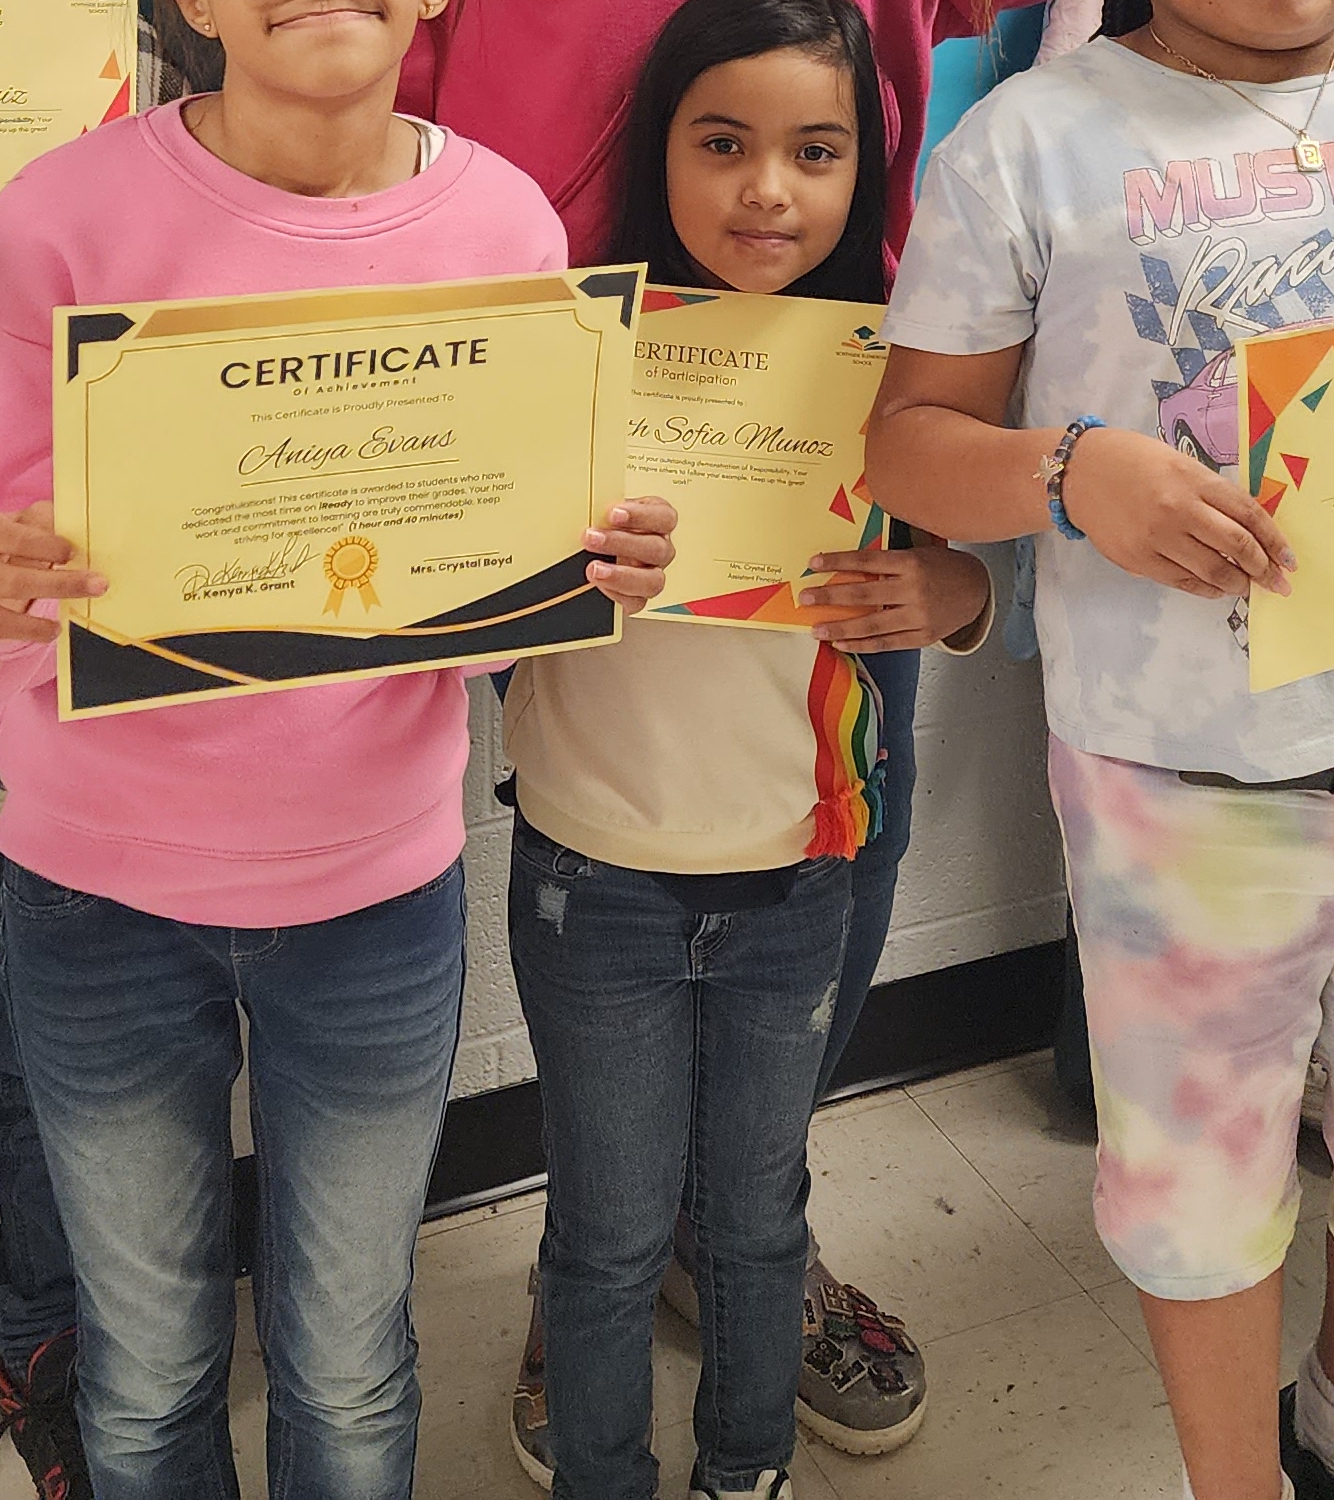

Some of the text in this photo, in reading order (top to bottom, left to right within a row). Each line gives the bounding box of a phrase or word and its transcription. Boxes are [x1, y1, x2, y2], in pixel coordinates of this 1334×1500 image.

[221, 338, 489, 389] CERTIFICATE
[634, 341, 769, 370] ERTIFICATE
[293, 377, 417, 396] Of Achievement
[645, 366, 737, 387] of Participation
[251, 393, 454, 422] This Certificate is Proudly Presented To
[238, 426, 457, 476] Aniya Evans
[654, 416, 729, 451] Sofia
[734, 422, 834, 457] Munoz
[300, 489, 348, 500] certificate
[361, 482, 403, 494] awarded
[417, 477, 458, 488] students
[460, 474, 479, 483] who
[482, 472, 505, 480] have
[181, 516, 231, 530] dedicated
[234, 513, 250, 521] the
[253, 509, 276, 518] most
[279, 506, 301, 514] time
[367, 494, 406, 507] improve
[408, 491, 429, 500] their
[432, 488, 466, 500] grades.
[469, 485, 489, 493] Your
[492, 481, 514, 491] hard
[195, 530, 218, 539] work
[221, 526, 240, 535] and
[243, 517, 306, 532] commitment
[321, 512, 359, 523] learning
[381, 505, 401, 515] truly
[404, 499, 475, 513] commendable.
[477, 496, 500, 505] Keep
[234, 533, 268, 545] striving
[349, 522, 357, 532] (1
[359, 520, 381, 529] hour
[383, 517, 402, 526] and
[405, 516, 417, 524] 40
[419, 509, 464, 522] minutes)
[411, 555, 512, 575] Mrs. Crystal Boyd
[183, 580, 295, 602] Dr. Kenya K. Grant
